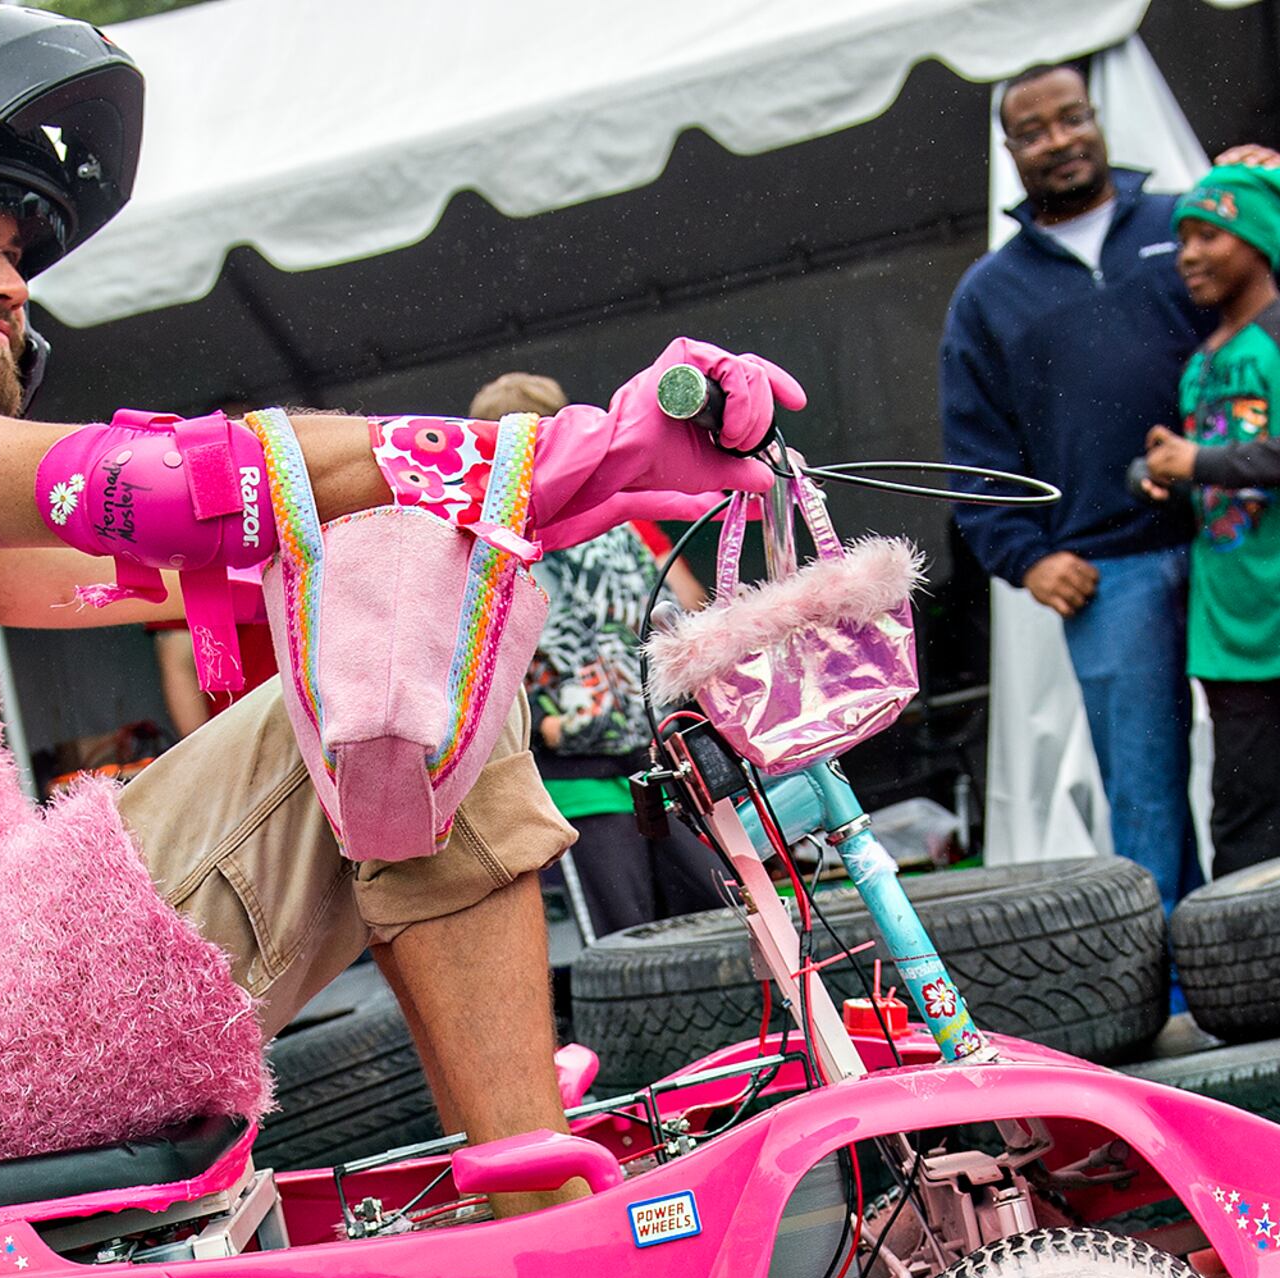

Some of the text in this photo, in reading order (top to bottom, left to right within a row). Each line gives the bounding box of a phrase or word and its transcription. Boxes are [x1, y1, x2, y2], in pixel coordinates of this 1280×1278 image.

[239, 466, 261, 548] Razor
[636, 1202, 684, 1224] POWER
[638, 1214, 692, 1237] WHEELS
